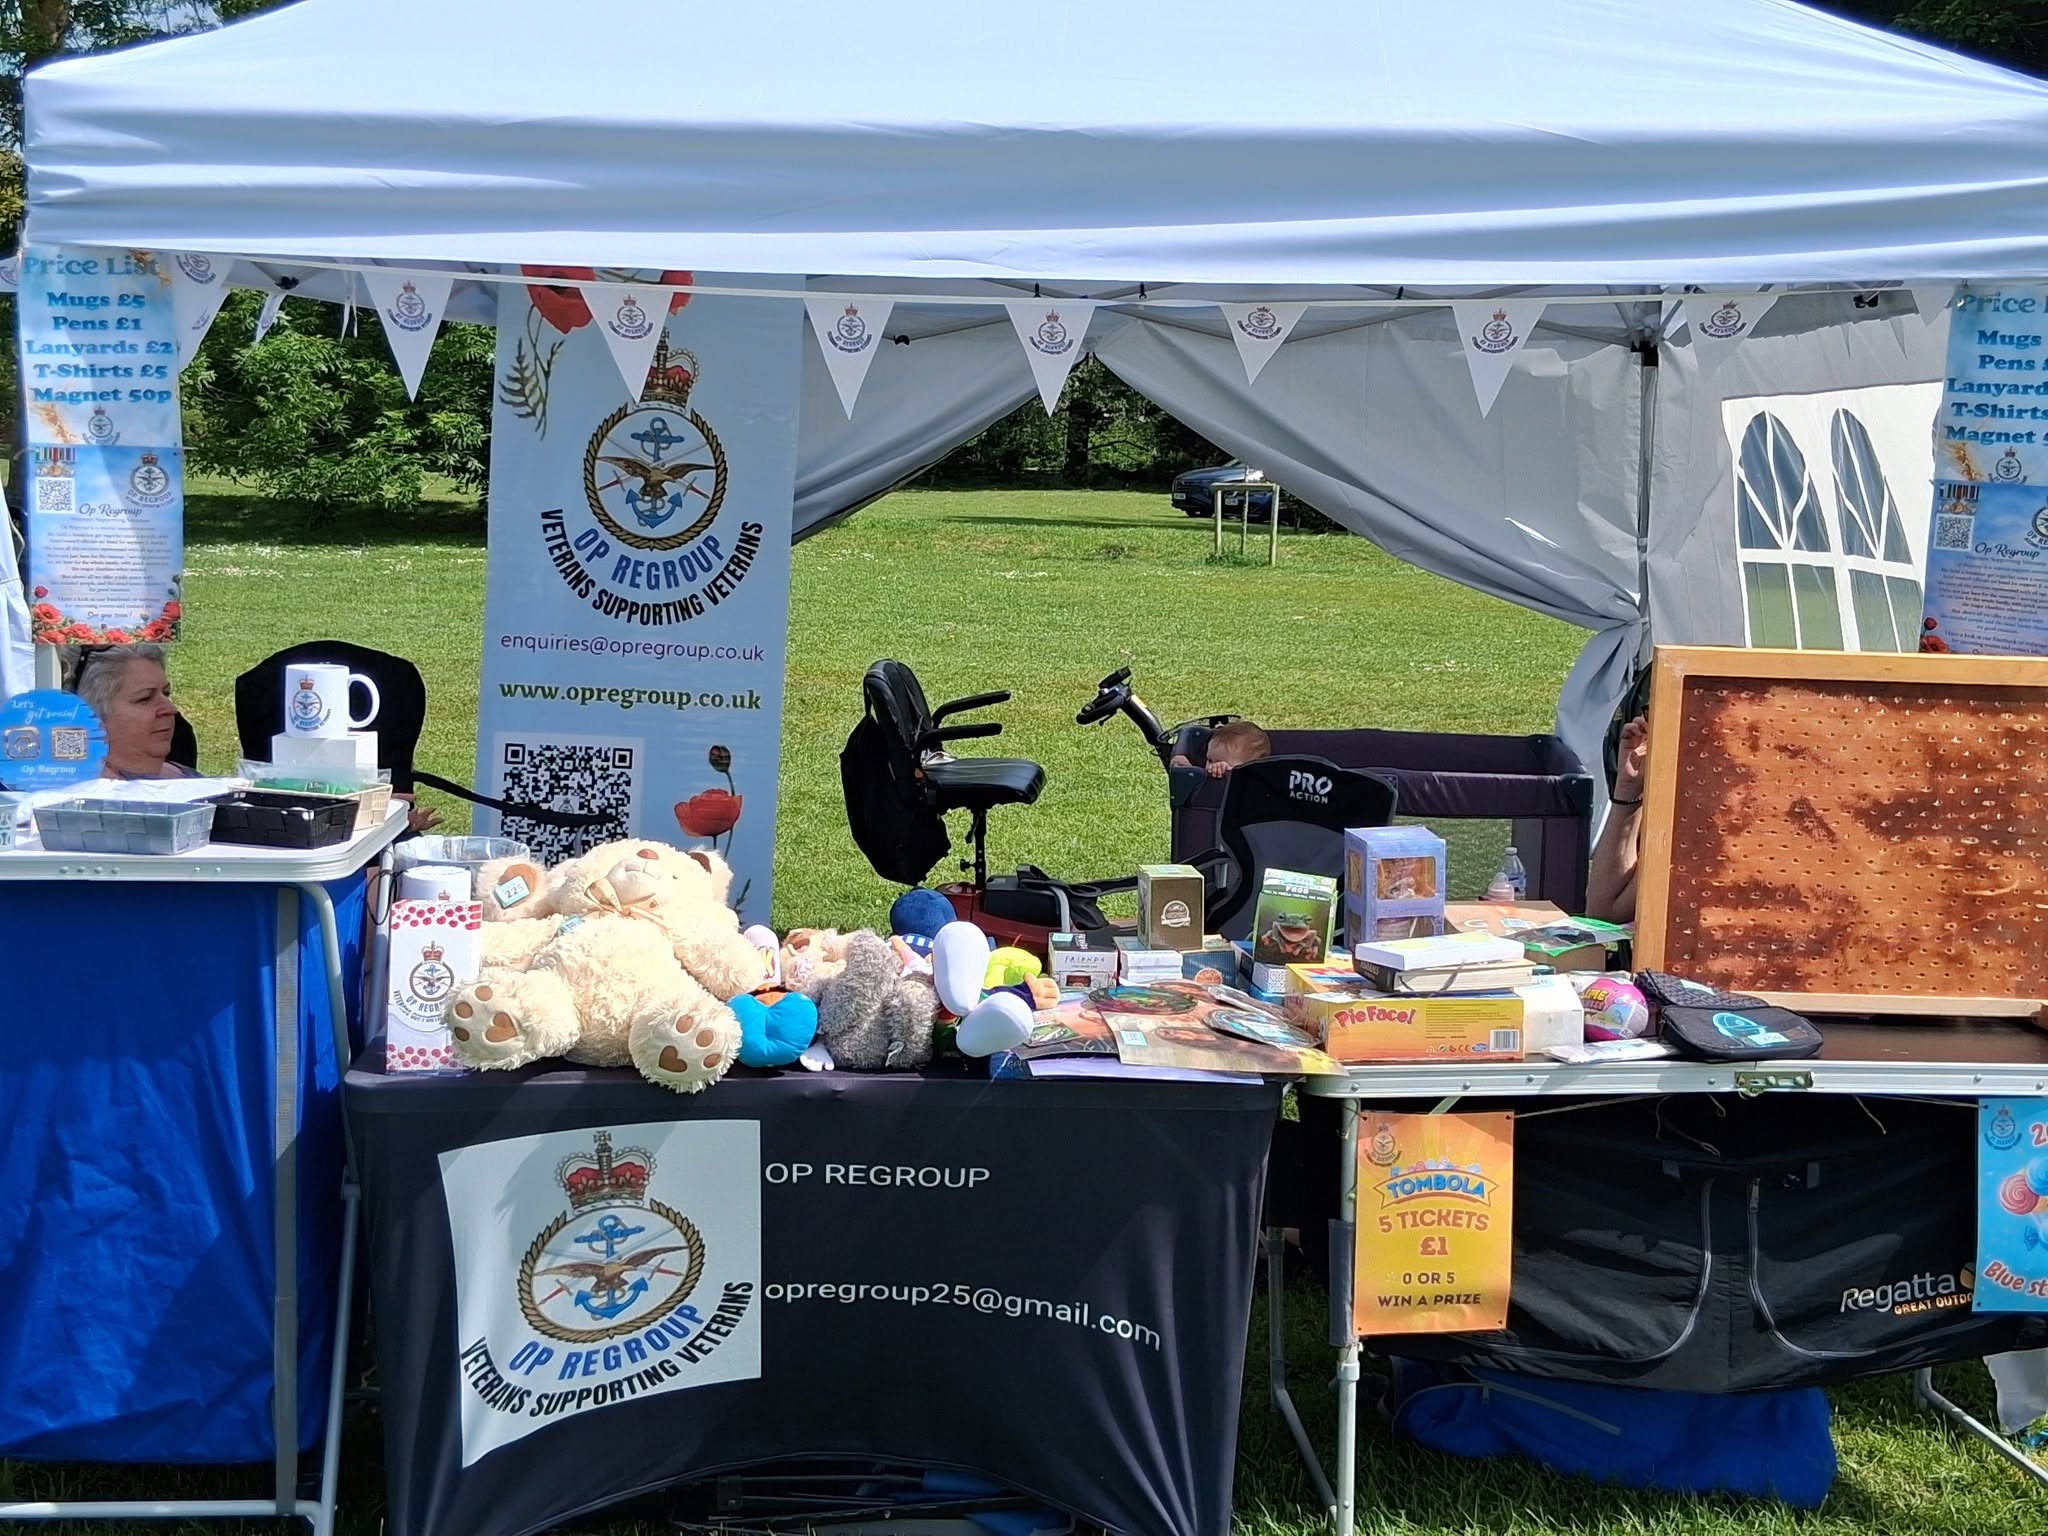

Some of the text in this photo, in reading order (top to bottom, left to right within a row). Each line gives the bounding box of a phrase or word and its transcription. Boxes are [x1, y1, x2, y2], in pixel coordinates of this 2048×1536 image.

[23, 254, 99, 276] Price
[47, 292, 146, 311] Mugs £5
[52, 316, 143, 331] Pens £1
[24, 340, 175, 357] Lanyards £2
[1977, 330, 2042, 349] Mugs
[33, 364, 168, 379] T-Shirts £5
[1979, 355, 2036, 371] Pens
[31, 387, 172, 405] Magnet 50p
[1945, 426, 2036, 445] Magnet
[79, 503, 143, 518] Op Regroup
[574, 528, 724, 590] OP REGROUP
[1975, 542, 1992, 556] Op
[1995, 543, 2040, 560] Regroup
[541, 509, 763, 626] VETERANS SUPPORTING VETERANS
[501, 634, 764, 661] enquiries@opregroup.co.uk
[499, 683, 762, 710] www.opregroup.co.uk
[1289, 770, 1333, 795] PRO
[1289, 790, 1329, 804] ACTION
[2031, 1123, 2048, 1146] 2
[765, 1162, 991, 1188] OP REGROUP
[1387, 1173, 1486, 1199] TOMBOLA
[1378, 1209, 1490, 1233] 5 TICKETS
[1420, 1236, 1449, 1256] £1
[1417, 1272, 1441, 1285] OR
[1446, 1272, 1455, 1284] 5
[1985, 1262, 2025, 1290] Blue
[1377, 1293, 1481, 1307] WIN A PRIZE
[1840, 1272, 1956, 1313] Regatta
[765, 1283, 1161, 1351] opregroup25@gmail.com
[1894, 1299, 1933, 1315] GREAT
[461, 1281, 754, 1418] VETERANS SUPPORTING VETERANS
[509, 1303, 705, 1381] OP REGROUP
